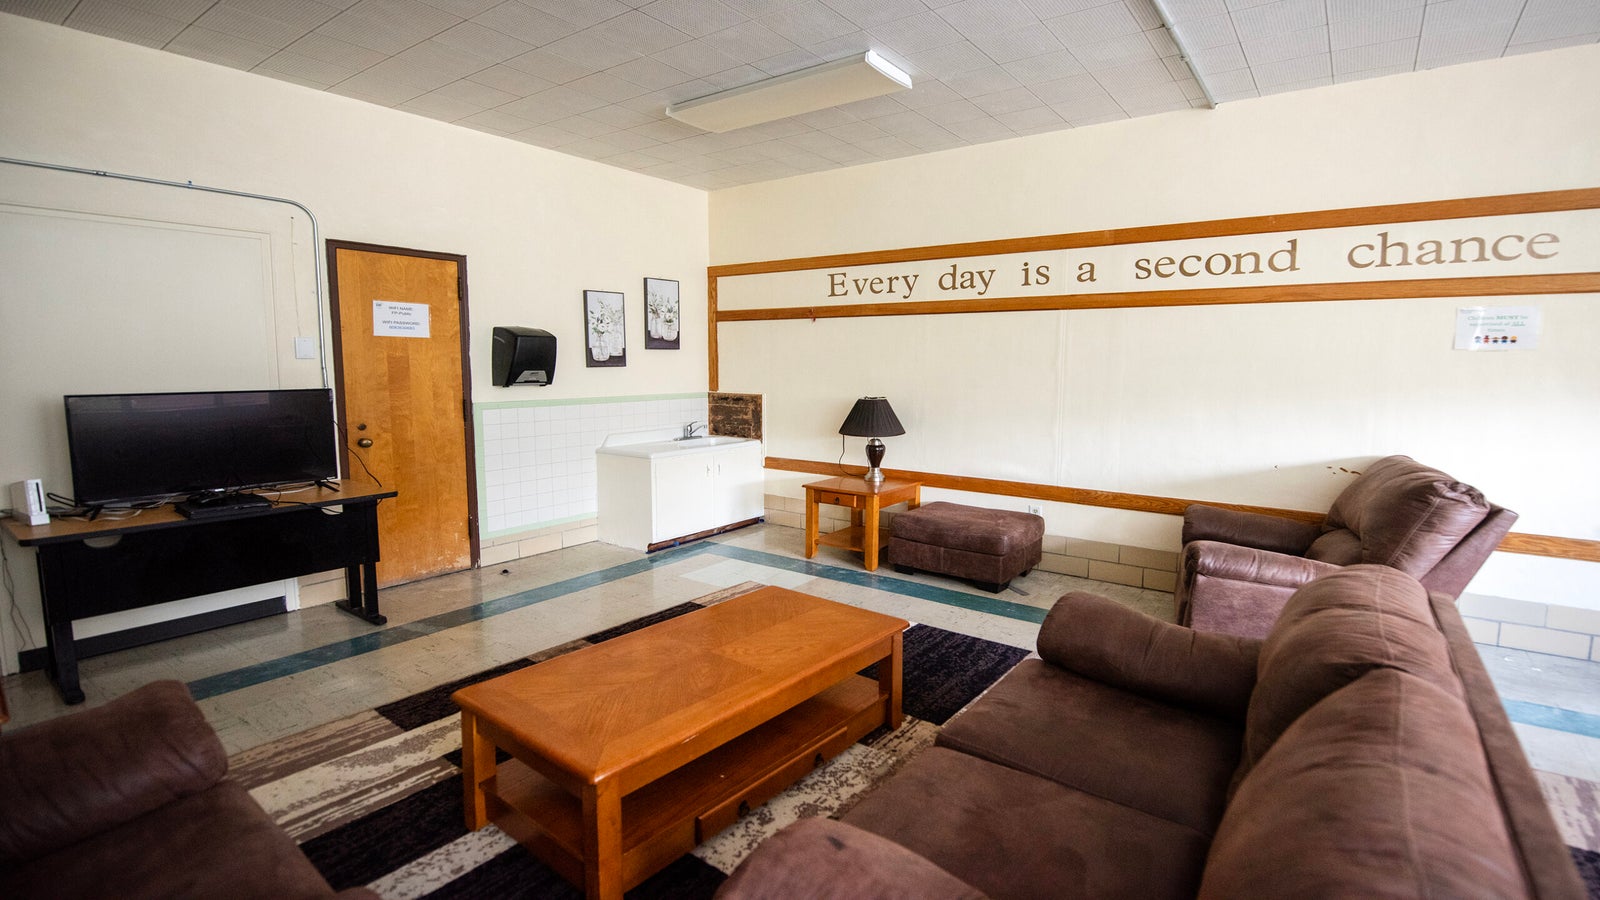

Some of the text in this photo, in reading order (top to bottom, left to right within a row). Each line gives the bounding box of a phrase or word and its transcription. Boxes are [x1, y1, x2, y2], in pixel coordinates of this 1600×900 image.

[827, 231, 1560, 299] Every day is a second chance
